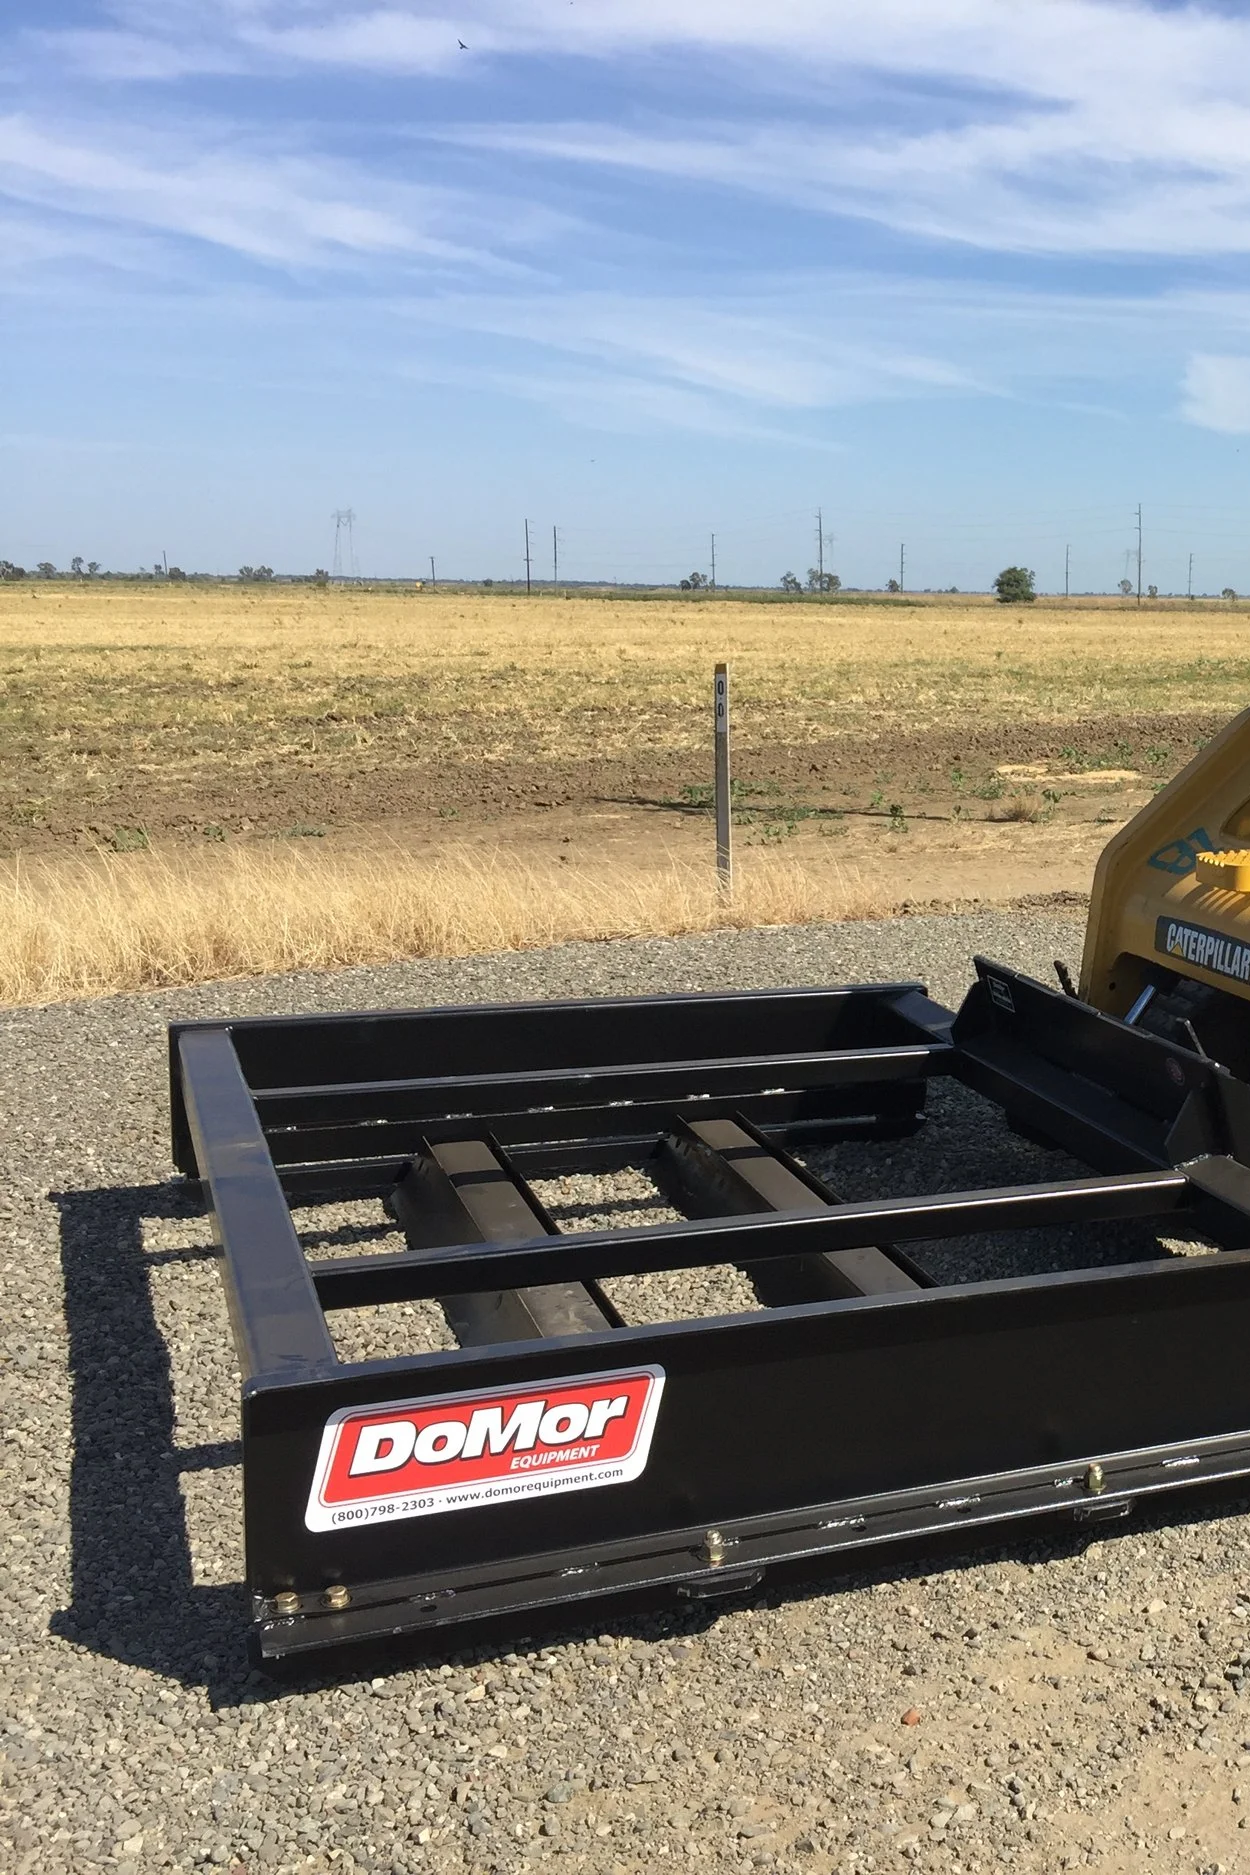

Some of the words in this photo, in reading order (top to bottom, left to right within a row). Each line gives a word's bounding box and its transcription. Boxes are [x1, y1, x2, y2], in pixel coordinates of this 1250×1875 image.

[349, 1395, 628, 1478] DoMor
[510, 1444, 601, 1470] EQUIPMENT
[331, 1497, 435, 1525] (800)798-2303
[445, 1466, 624, 1505] www.domorequipment.com
